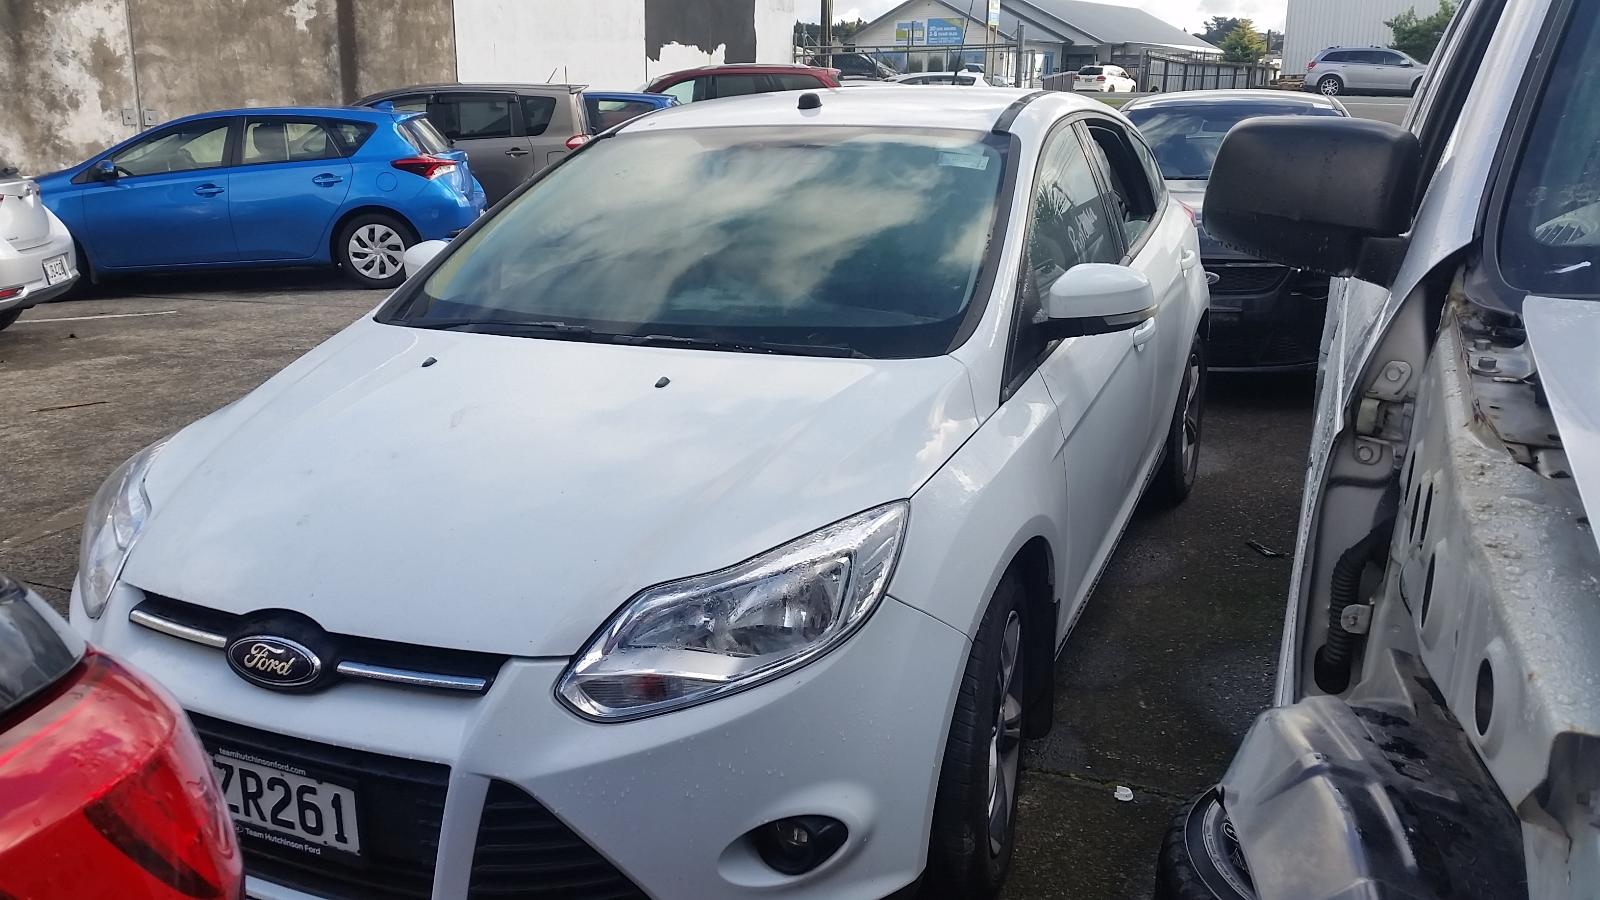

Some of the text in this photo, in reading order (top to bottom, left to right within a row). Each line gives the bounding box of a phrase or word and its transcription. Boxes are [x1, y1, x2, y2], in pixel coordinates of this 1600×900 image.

[244, 643, 295, 675] Ford
[218, 747, 306, 776] teamhutchinsonford.com
[245, 827, 264, 839] Team
[264, 833, 304, 850] Hutchinson
[304, 844, 321, 855] Ford
